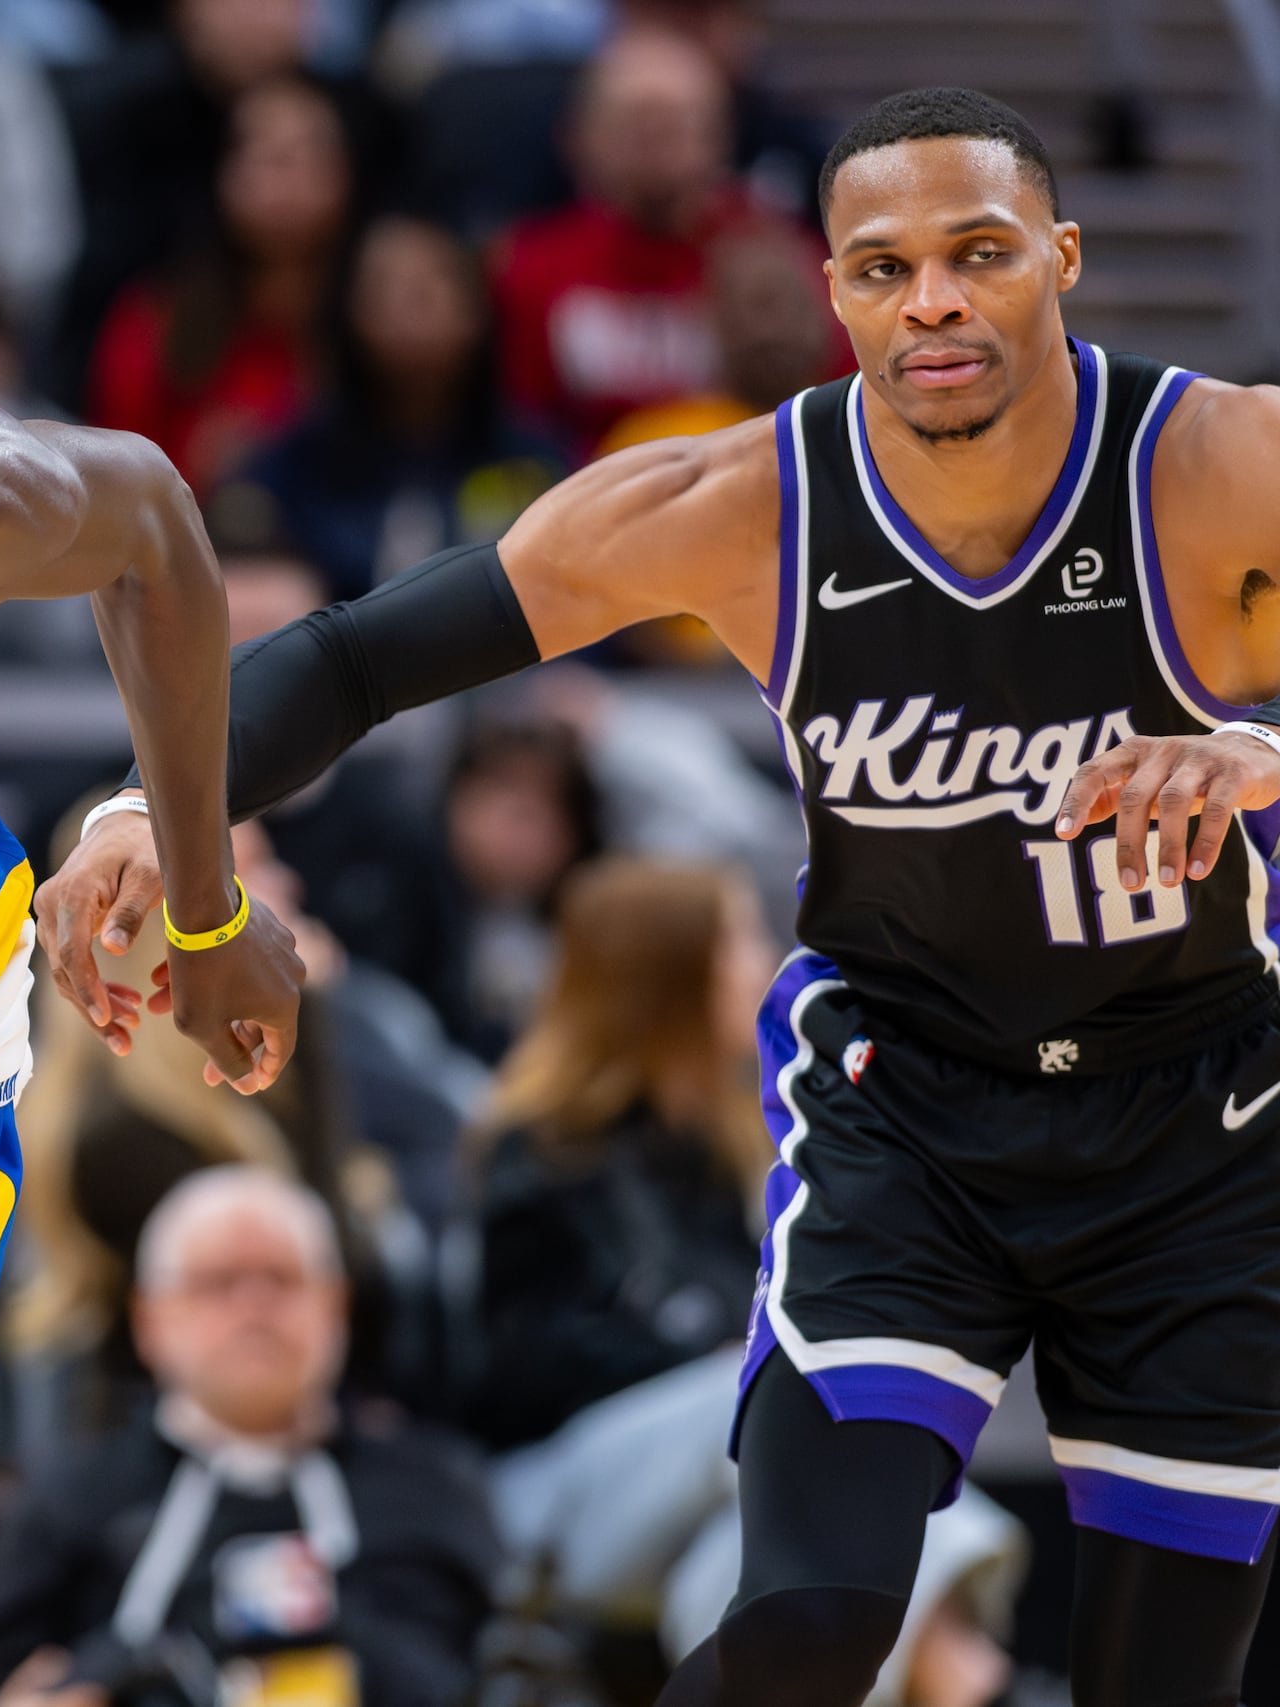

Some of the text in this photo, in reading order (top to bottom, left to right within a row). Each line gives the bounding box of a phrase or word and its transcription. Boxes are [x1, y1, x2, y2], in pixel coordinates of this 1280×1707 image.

[1044, 597, 1127, 615] PHOONG LAW
[1020, 827, 1191, 948] 18
